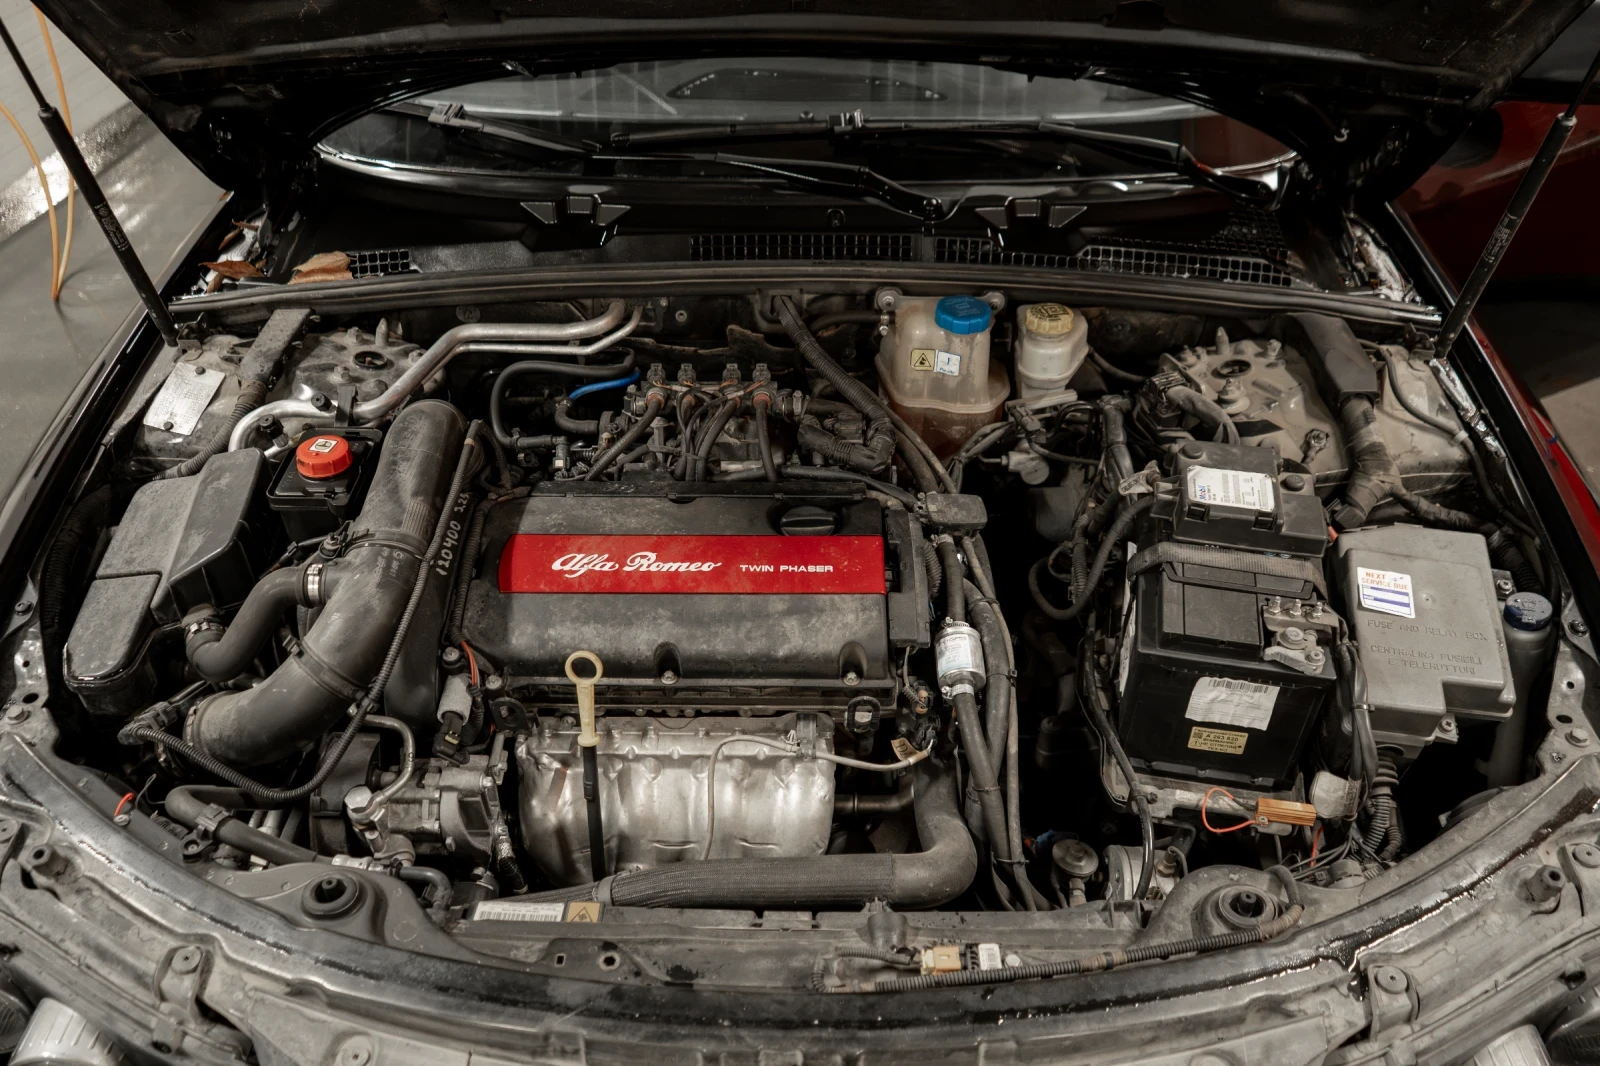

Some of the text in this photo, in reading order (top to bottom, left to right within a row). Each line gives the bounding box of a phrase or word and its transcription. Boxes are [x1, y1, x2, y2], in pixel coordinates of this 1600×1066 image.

[436, 520, 461, 576] 120400
[551, 551, 722, 578] Alfa Romeo
[740, 564, 834, 573] TWIN PHASER
[1361, 577, 1408, 590] SERVICE DUE
[1366, 572, 1386, 580] NEXT
[1367, 620, 1488, 641] FUSE AND RELAY BOX
[1370, 645, 1482, 665] CENTRALINA FUSIBILI
[1402, 660, 1476, 674] TELERUTTORI
